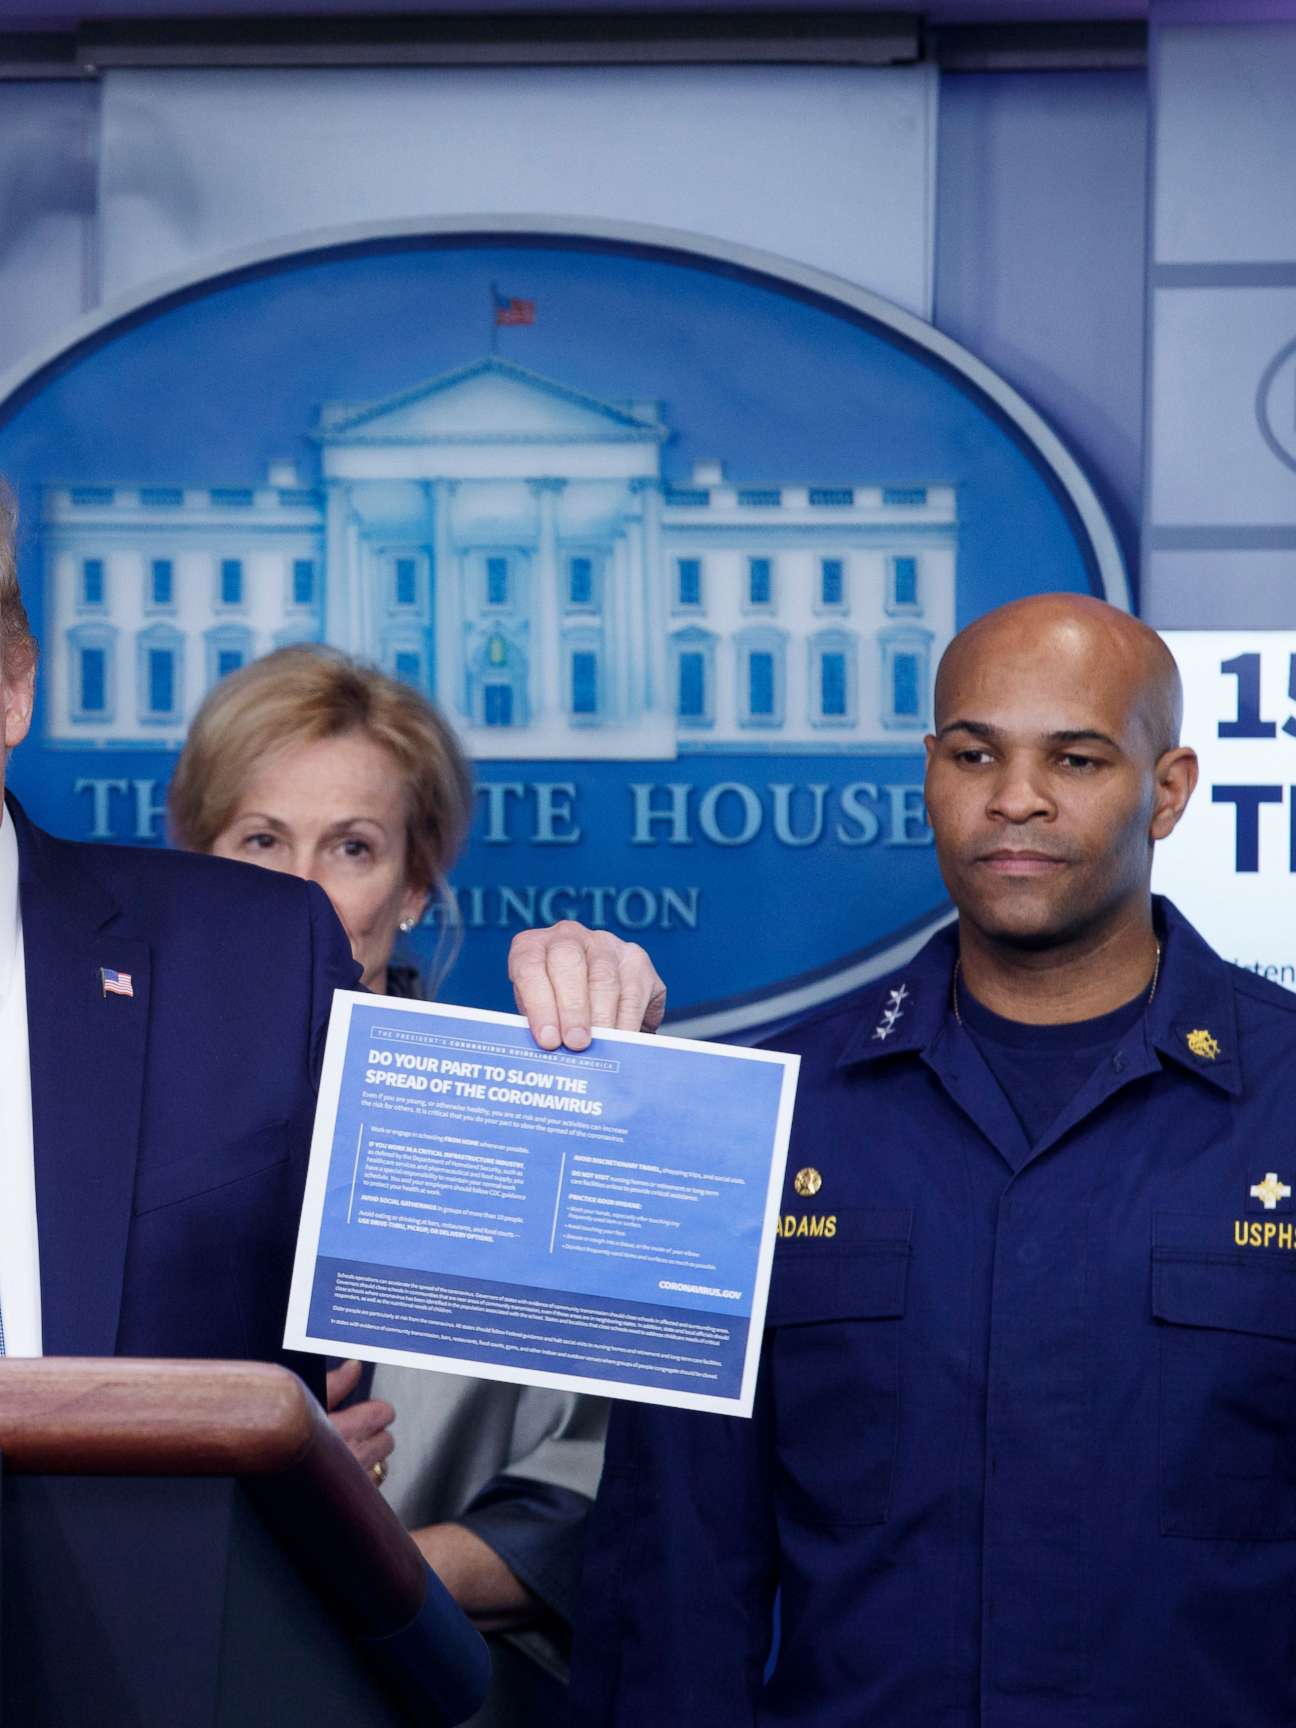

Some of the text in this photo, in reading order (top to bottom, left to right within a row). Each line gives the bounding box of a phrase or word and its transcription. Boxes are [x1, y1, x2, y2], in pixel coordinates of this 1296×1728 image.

[73, 778, 170, 837] TH
[630, 782, 934, 845] HOUSE
[421, 886, 700, 928] HINGTON
[368, 1049, 586, 1092] DO YOUR PART TO SLOW THE
[364, 1069, 601, 1115] SPREAD OF THE CORONAVIRUS
[1234, 1220, 1296, 1249] USPH
[658, 1280, 741, 1299] CORONAVIRUS.GOV
